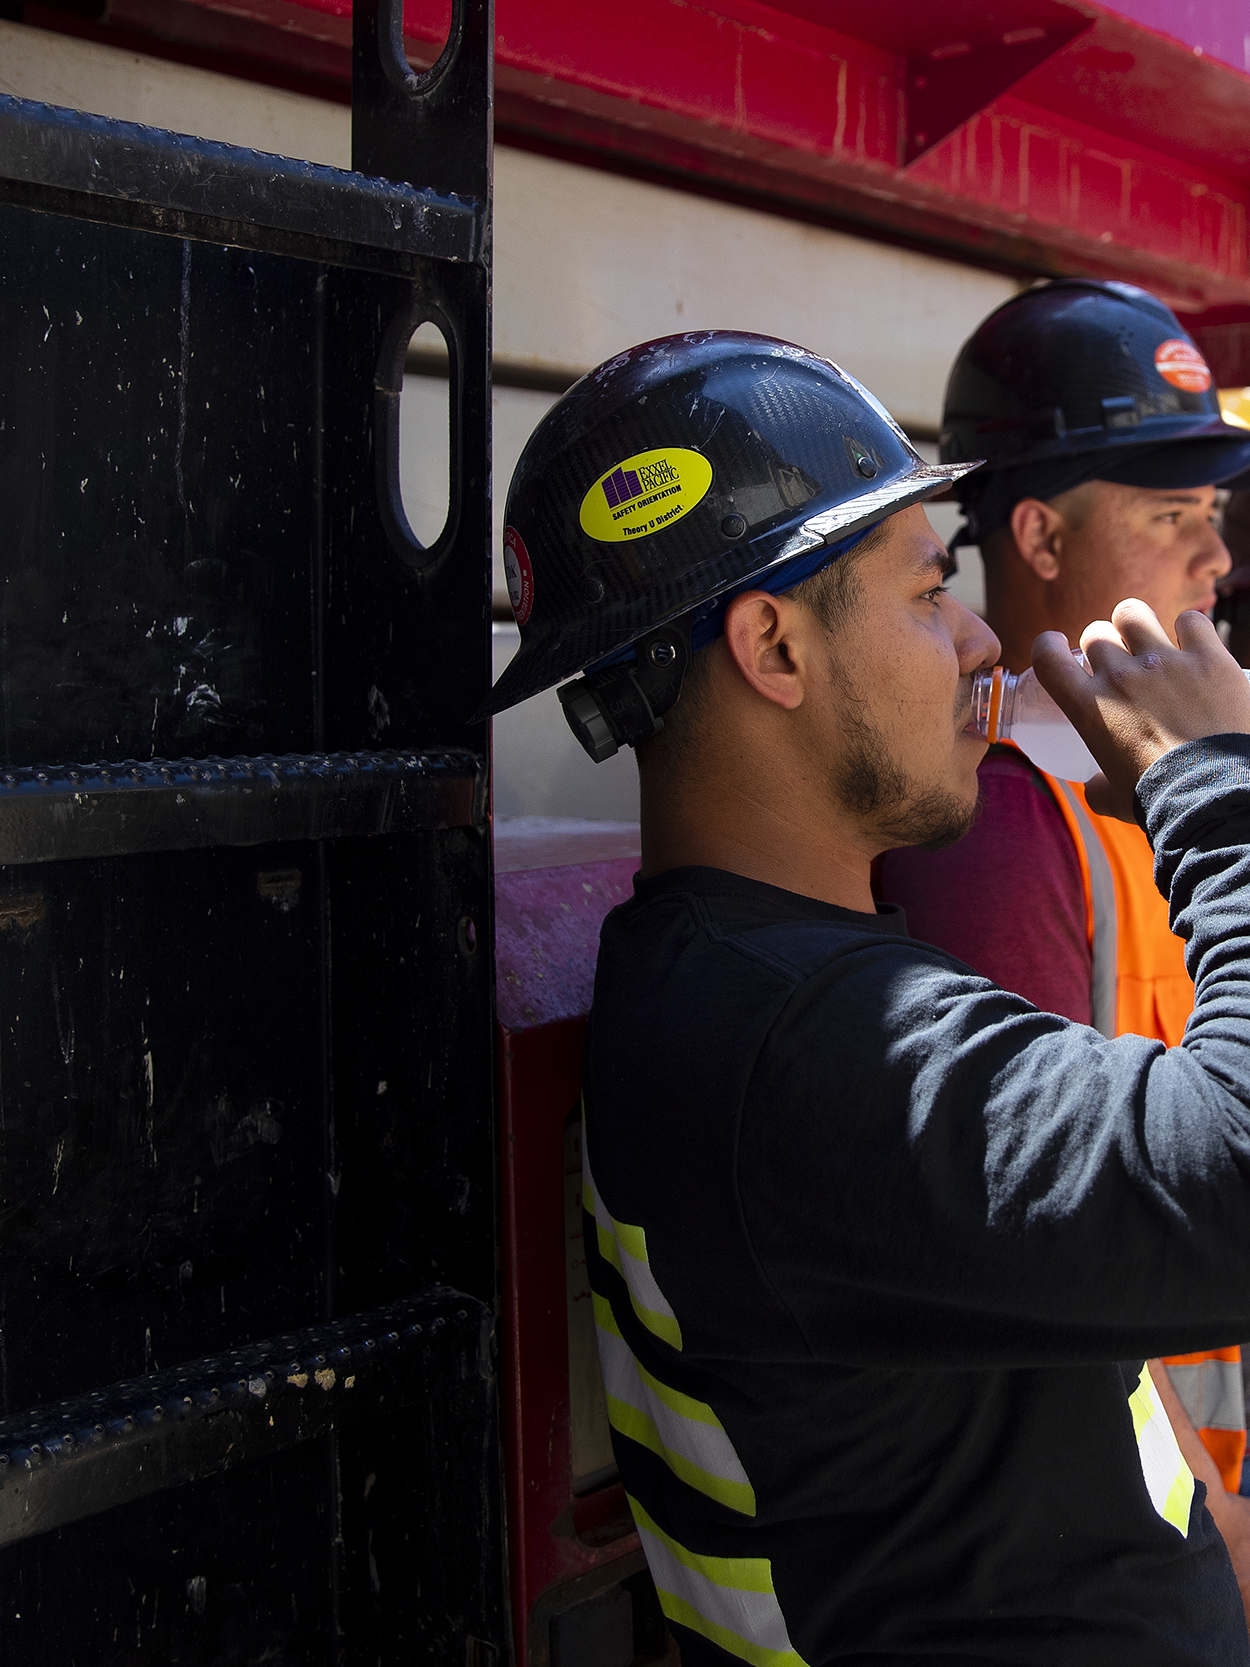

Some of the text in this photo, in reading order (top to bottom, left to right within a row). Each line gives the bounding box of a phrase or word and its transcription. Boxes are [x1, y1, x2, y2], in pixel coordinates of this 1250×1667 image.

[638, 459, 672, 480] EXXEL
[642, 467, 680, 491] PACIFIC
[612, 484, 682, 521] SAFETY ORIENTATION
[622, 504, 684, 536] Theory U District
